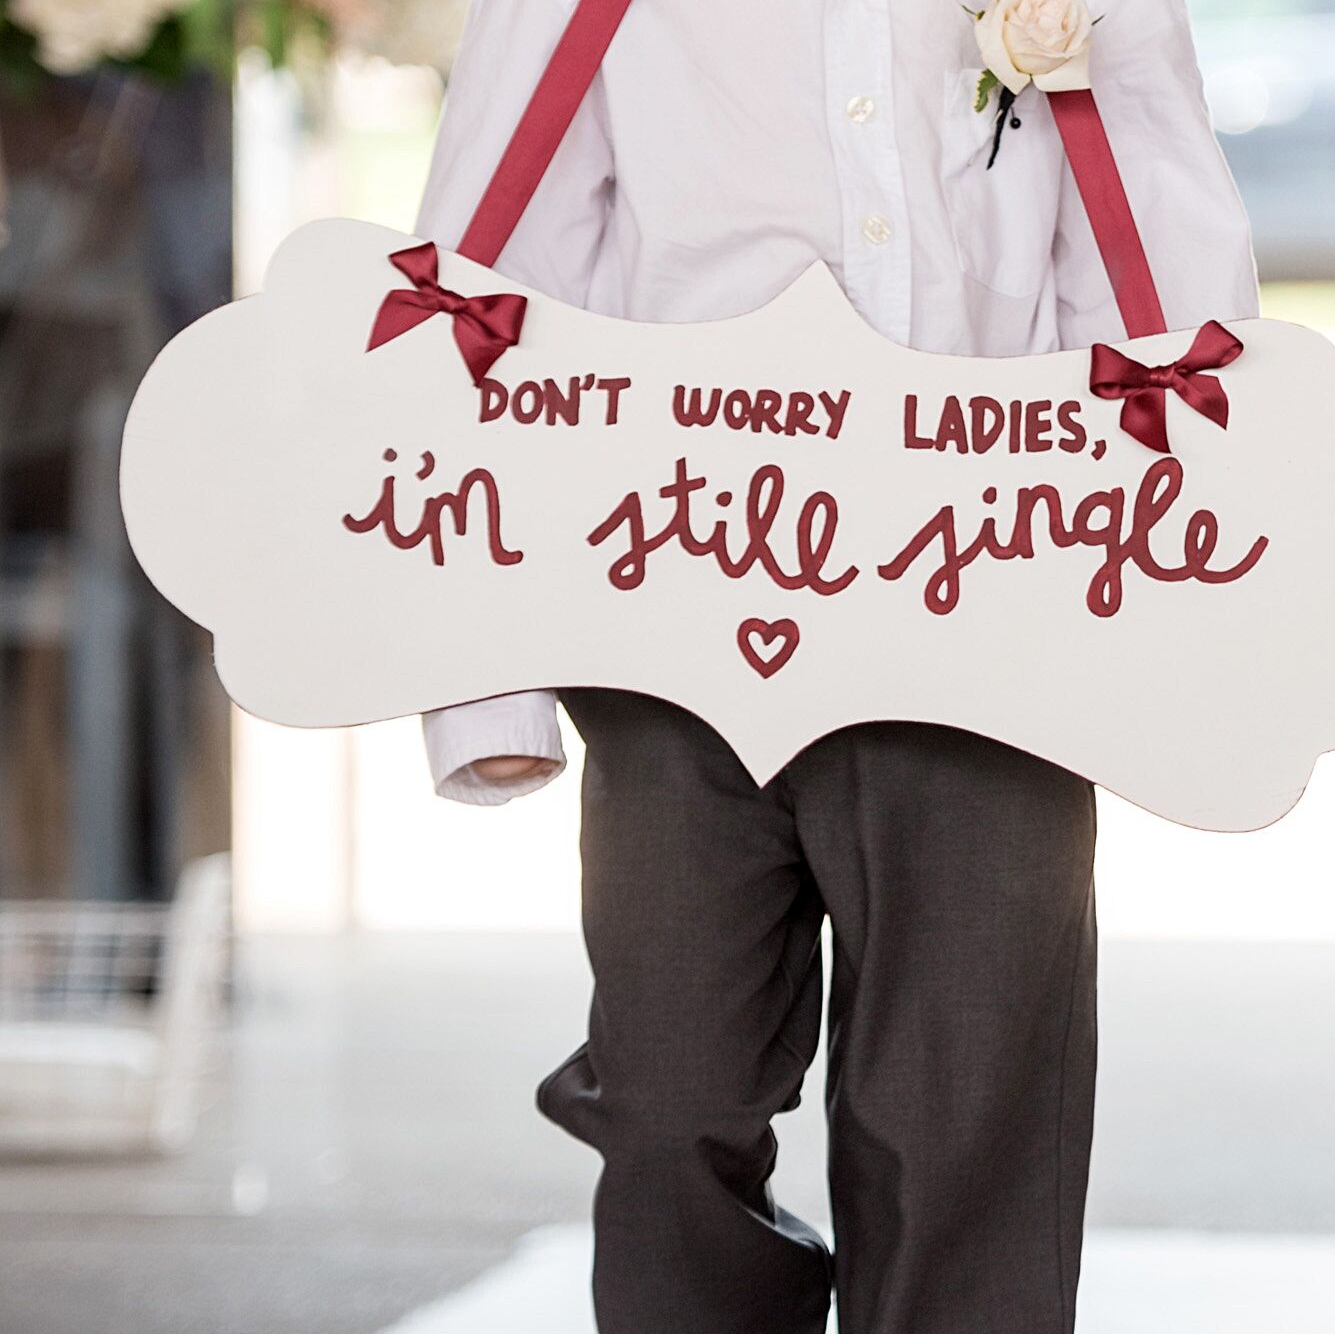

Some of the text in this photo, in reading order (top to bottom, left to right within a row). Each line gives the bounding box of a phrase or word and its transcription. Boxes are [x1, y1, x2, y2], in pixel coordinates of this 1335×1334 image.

[479, 373, 1108, 460] DON'T WORRY LADIES,
[343, 448, 1269, 618] i'm still single
